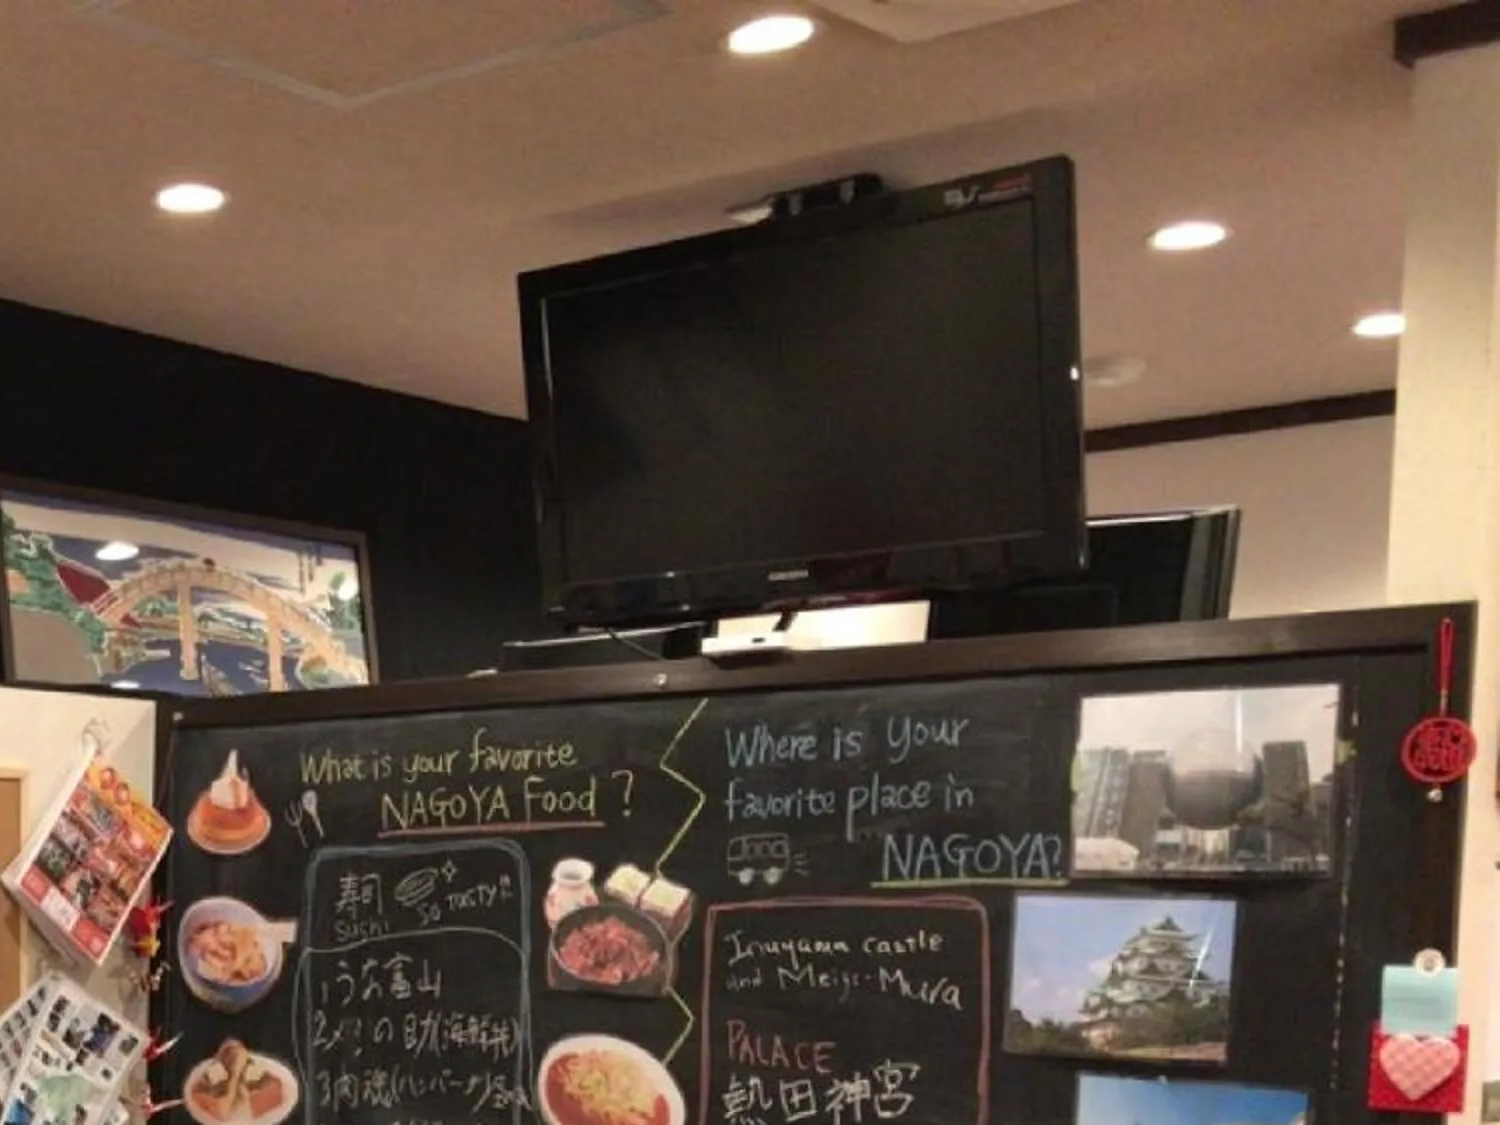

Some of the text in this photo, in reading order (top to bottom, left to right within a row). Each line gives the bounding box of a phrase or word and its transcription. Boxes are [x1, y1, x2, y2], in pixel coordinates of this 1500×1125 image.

[301, 727, 578, 784] What is your favorite
[724, 716, 970, 769] Where is your
[381, 784, 510, 831] NAGOYA
[724, 772, 975, 844] favorite place in
[726, 1018, 837, 1074] PALACE
